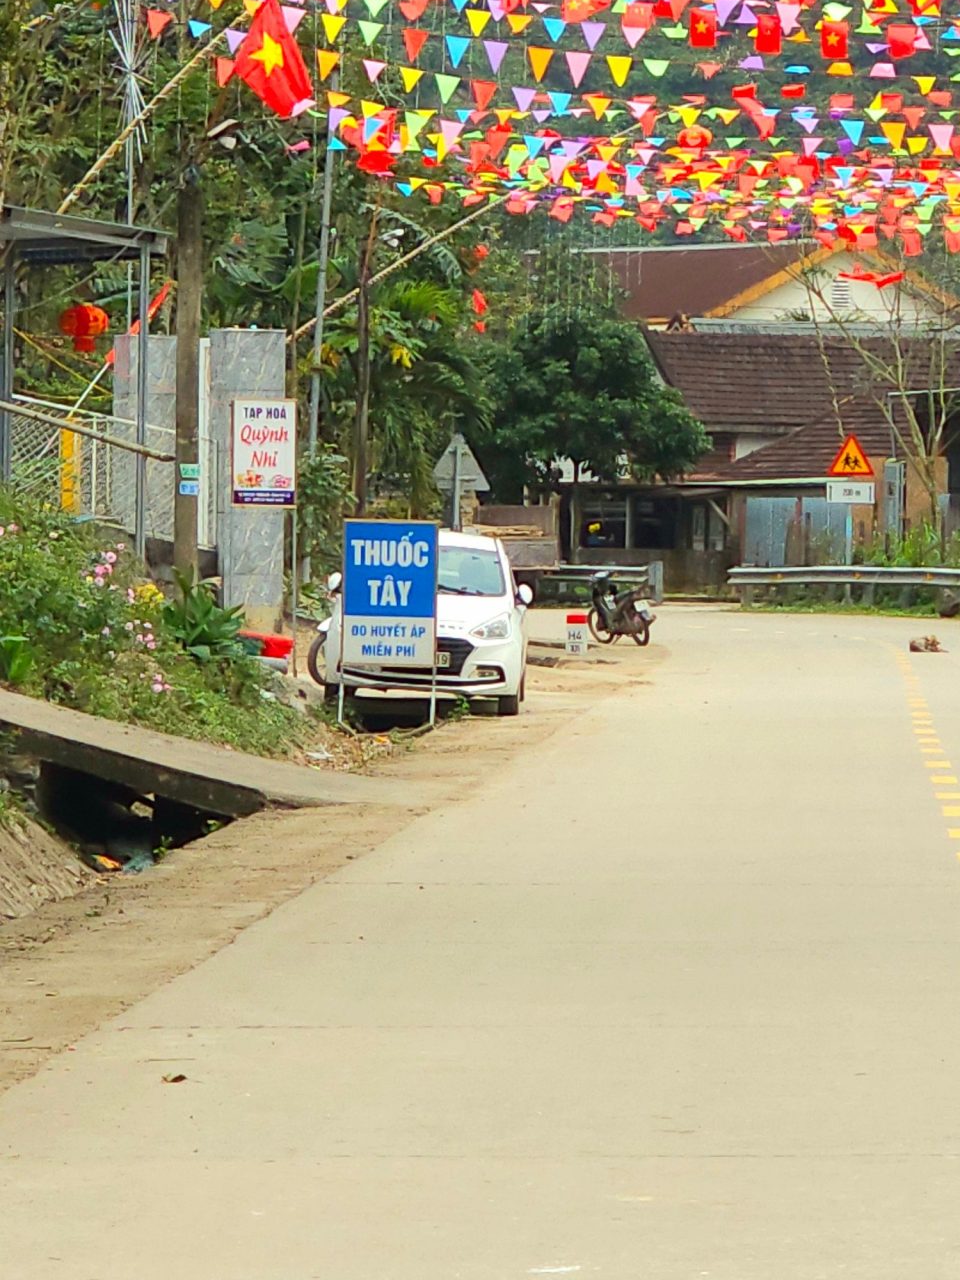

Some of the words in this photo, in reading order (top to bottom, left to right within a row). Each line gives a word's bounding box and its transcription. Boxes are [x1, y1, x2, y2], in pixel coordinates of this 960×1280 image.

[244, 407, 263, 421] TẠP
[266, 405, 287, 419] HOÁ
[240, 424, 289, 446] Quỳnh
[350, 531, 430, 568] THUỐC
[367, 574, 413, 607] TÂY
[370, 622, 407, 638] HUYẾT
[410, 624, 427, 638] ÁP
[396, 643, 416, 658] PHÍ
